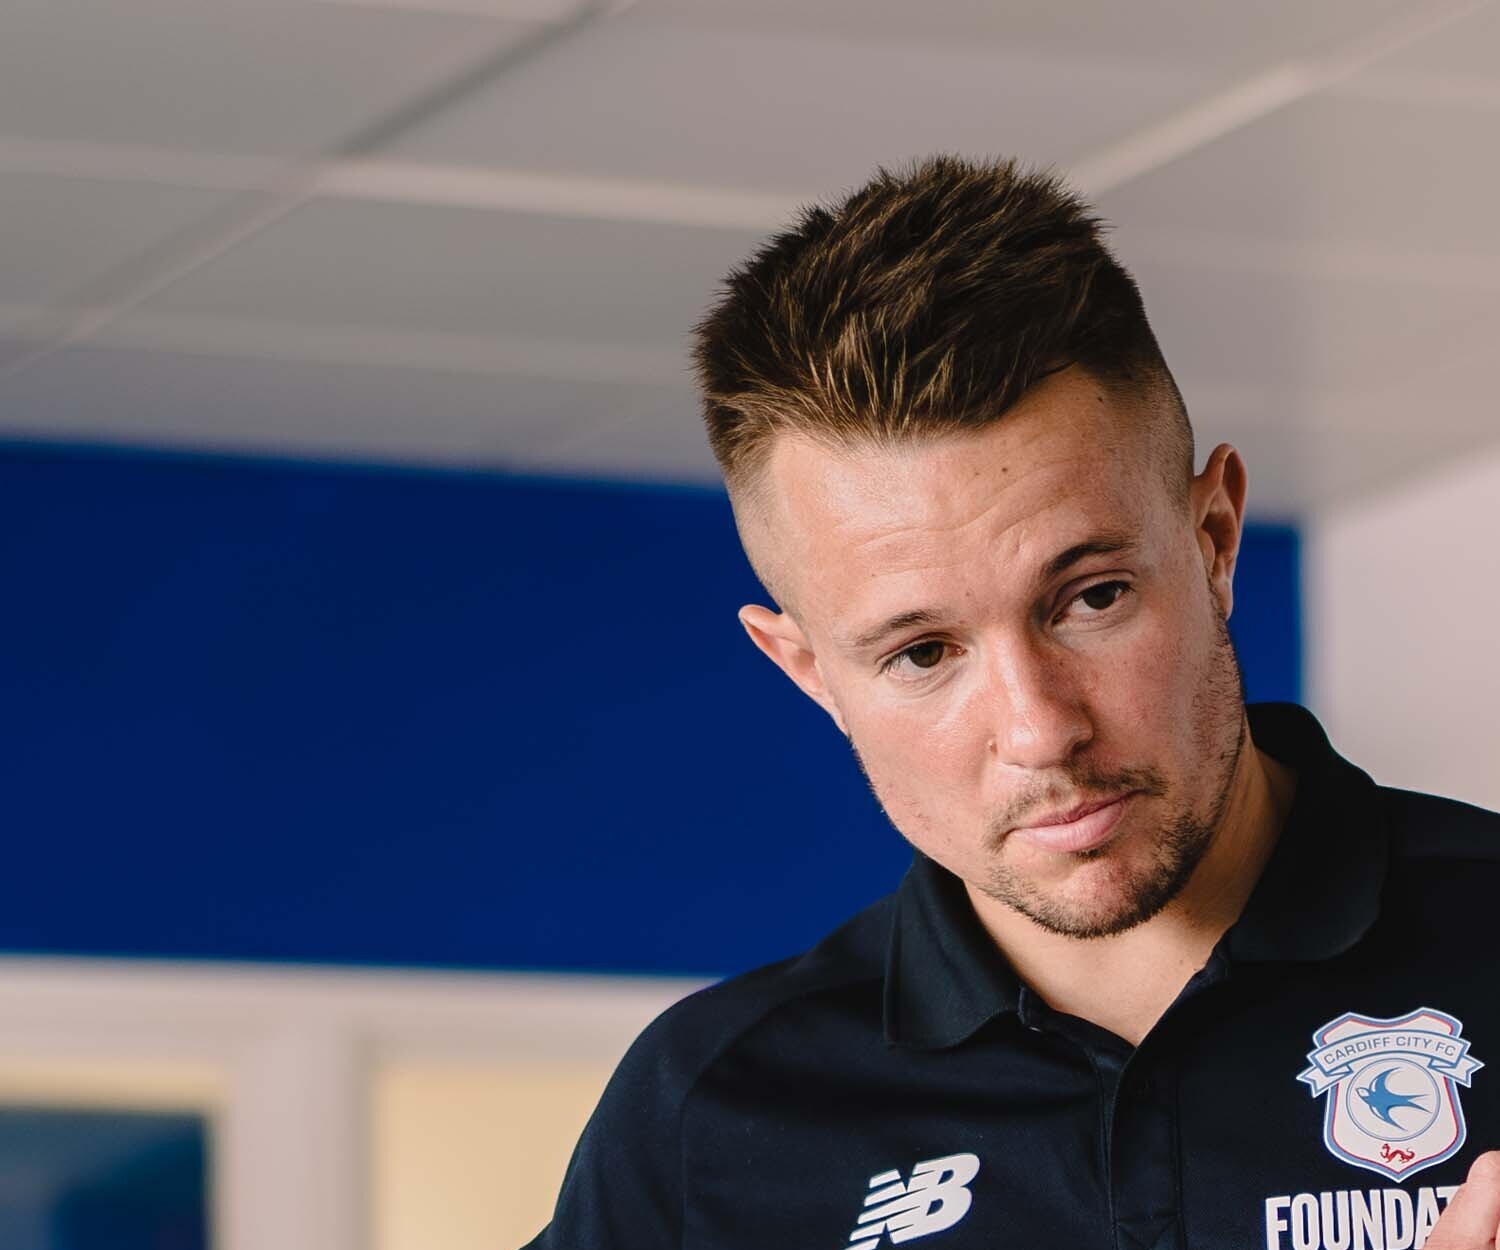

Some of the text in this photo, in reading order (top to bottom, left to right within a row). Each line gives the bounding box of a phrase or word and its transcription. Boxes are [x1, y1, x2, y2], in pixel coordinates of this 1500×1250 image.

[1324, 1036, 1456, 1064] CARDIFF CITY FC
